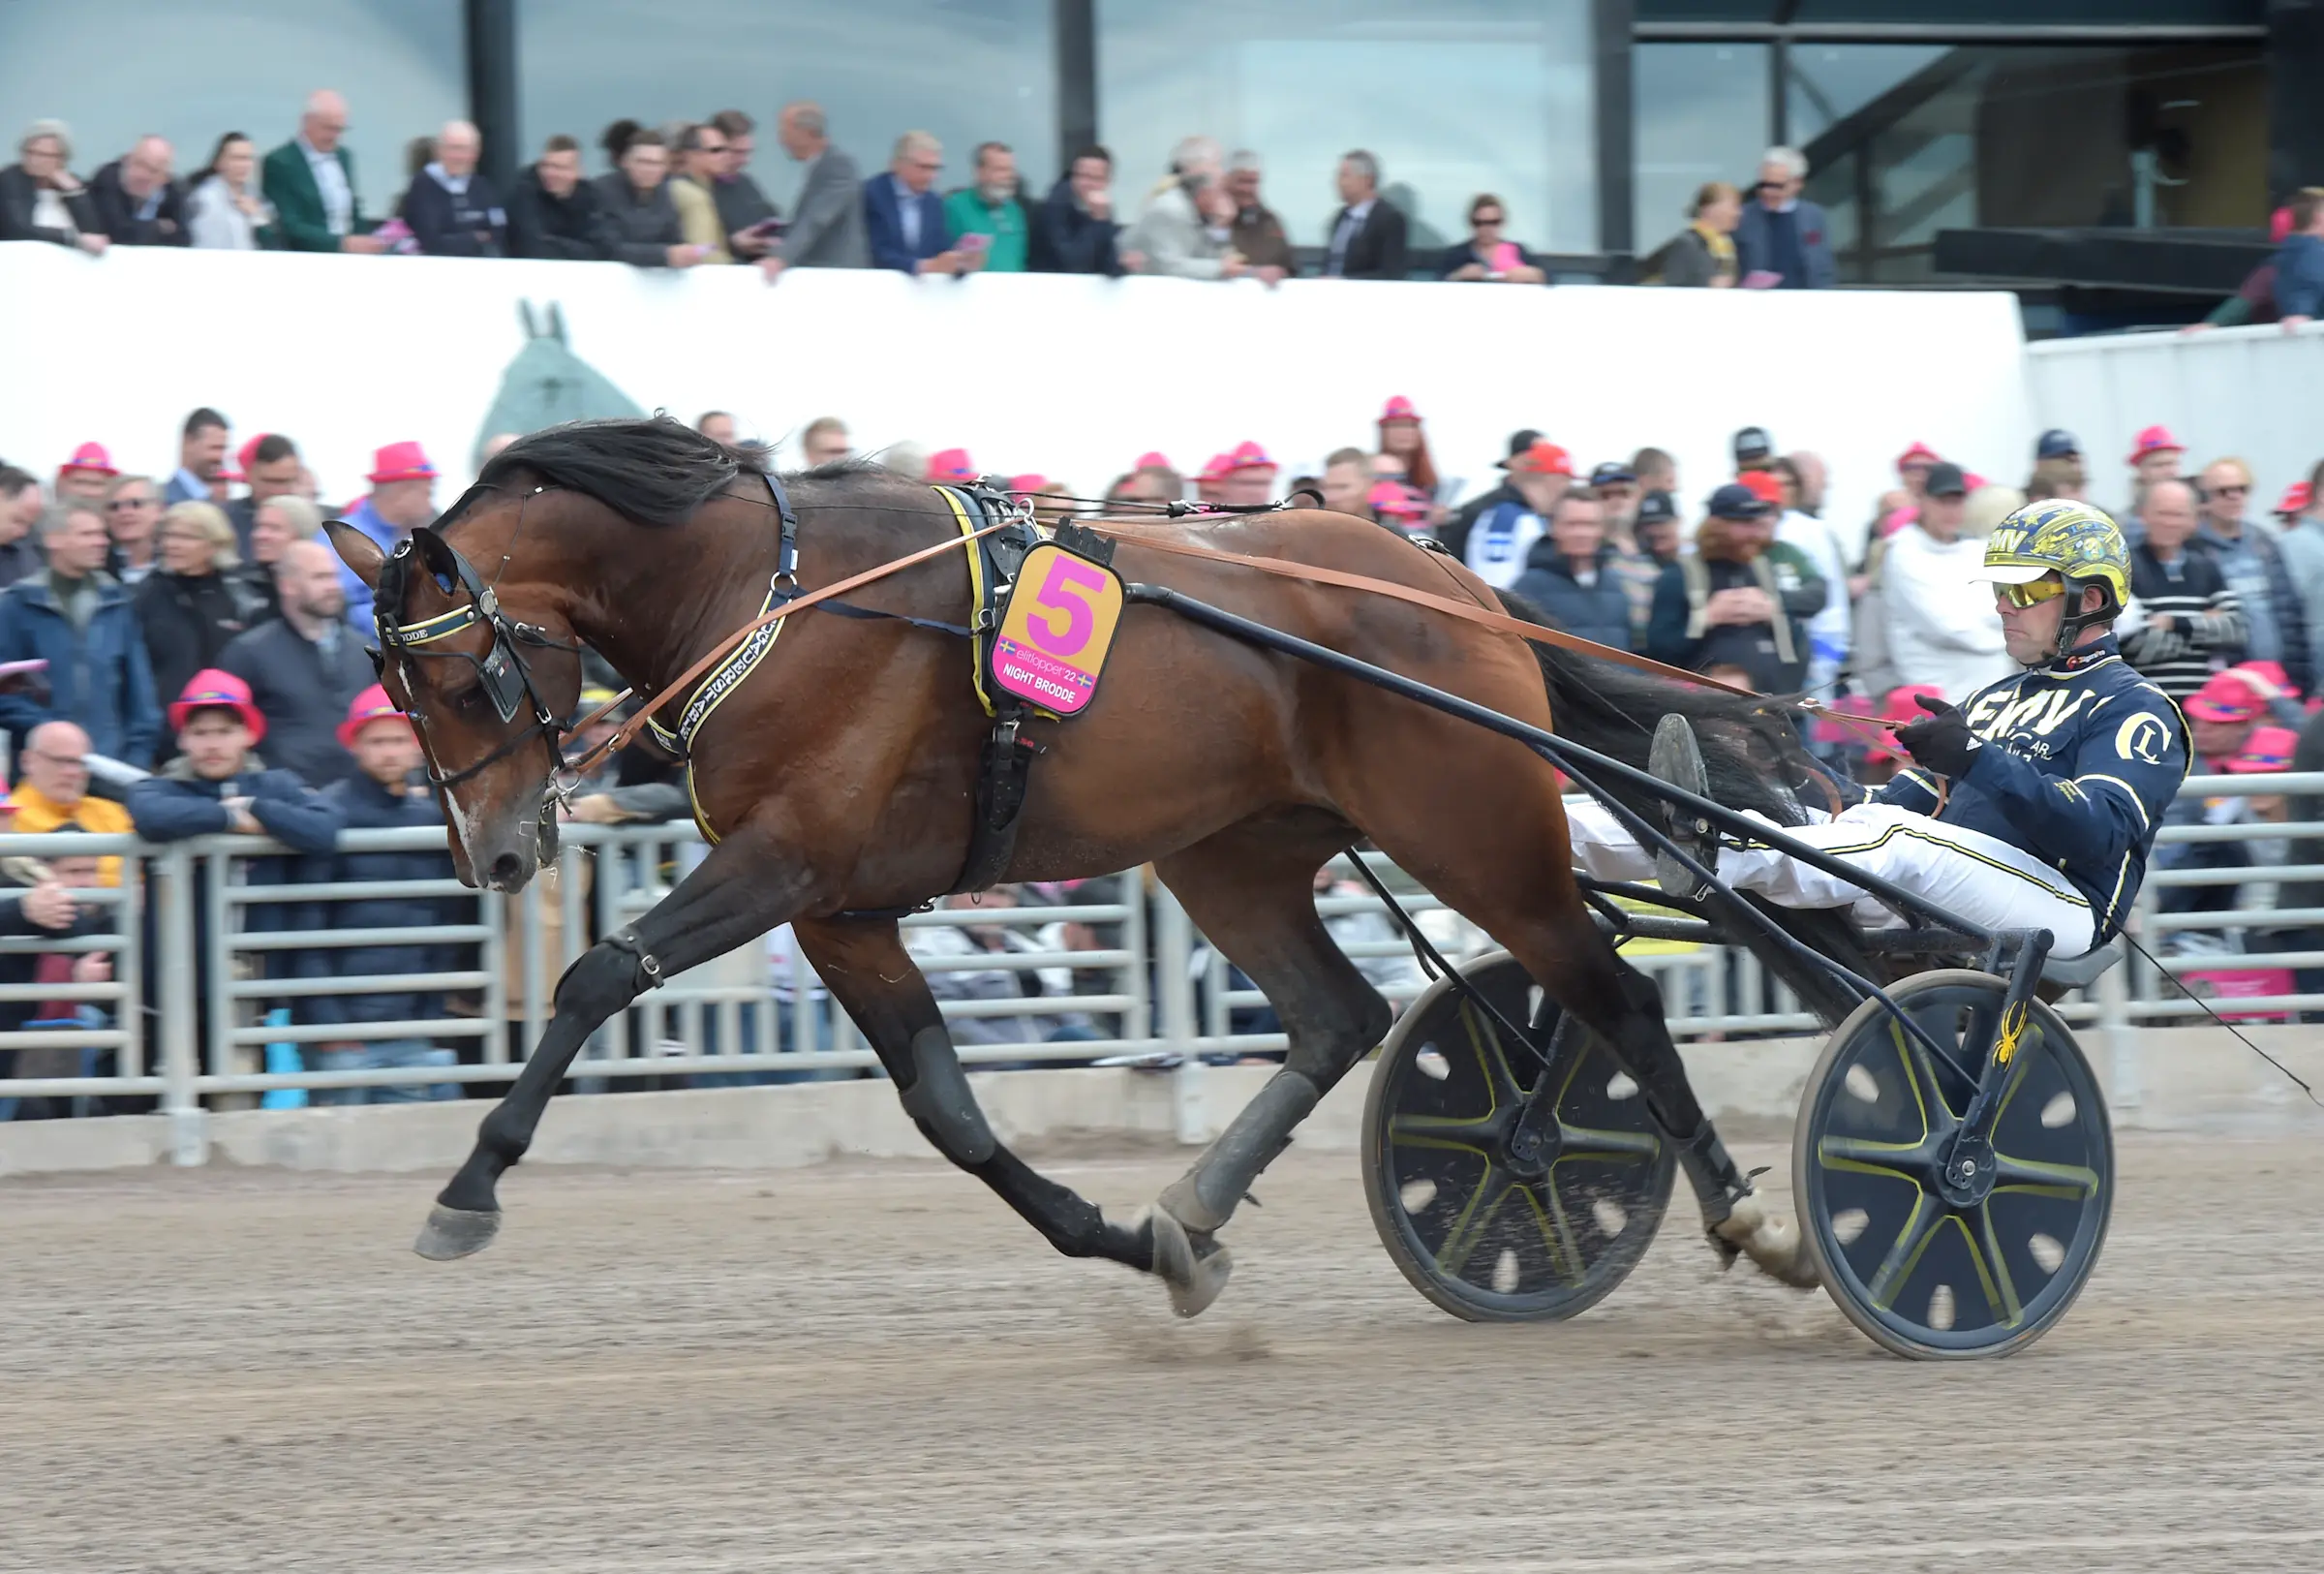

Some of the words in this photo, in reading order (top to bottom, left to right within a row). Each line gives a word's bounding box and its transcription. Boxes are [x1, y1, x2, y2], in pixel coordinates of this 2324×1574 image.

[1026, 553, 1107, 657] 5
[1003, 663, 1035, 686] NIGHT
[1034, 676, 1076, 704] BRODDE
[1968, 683, 2095, 742] EMV
